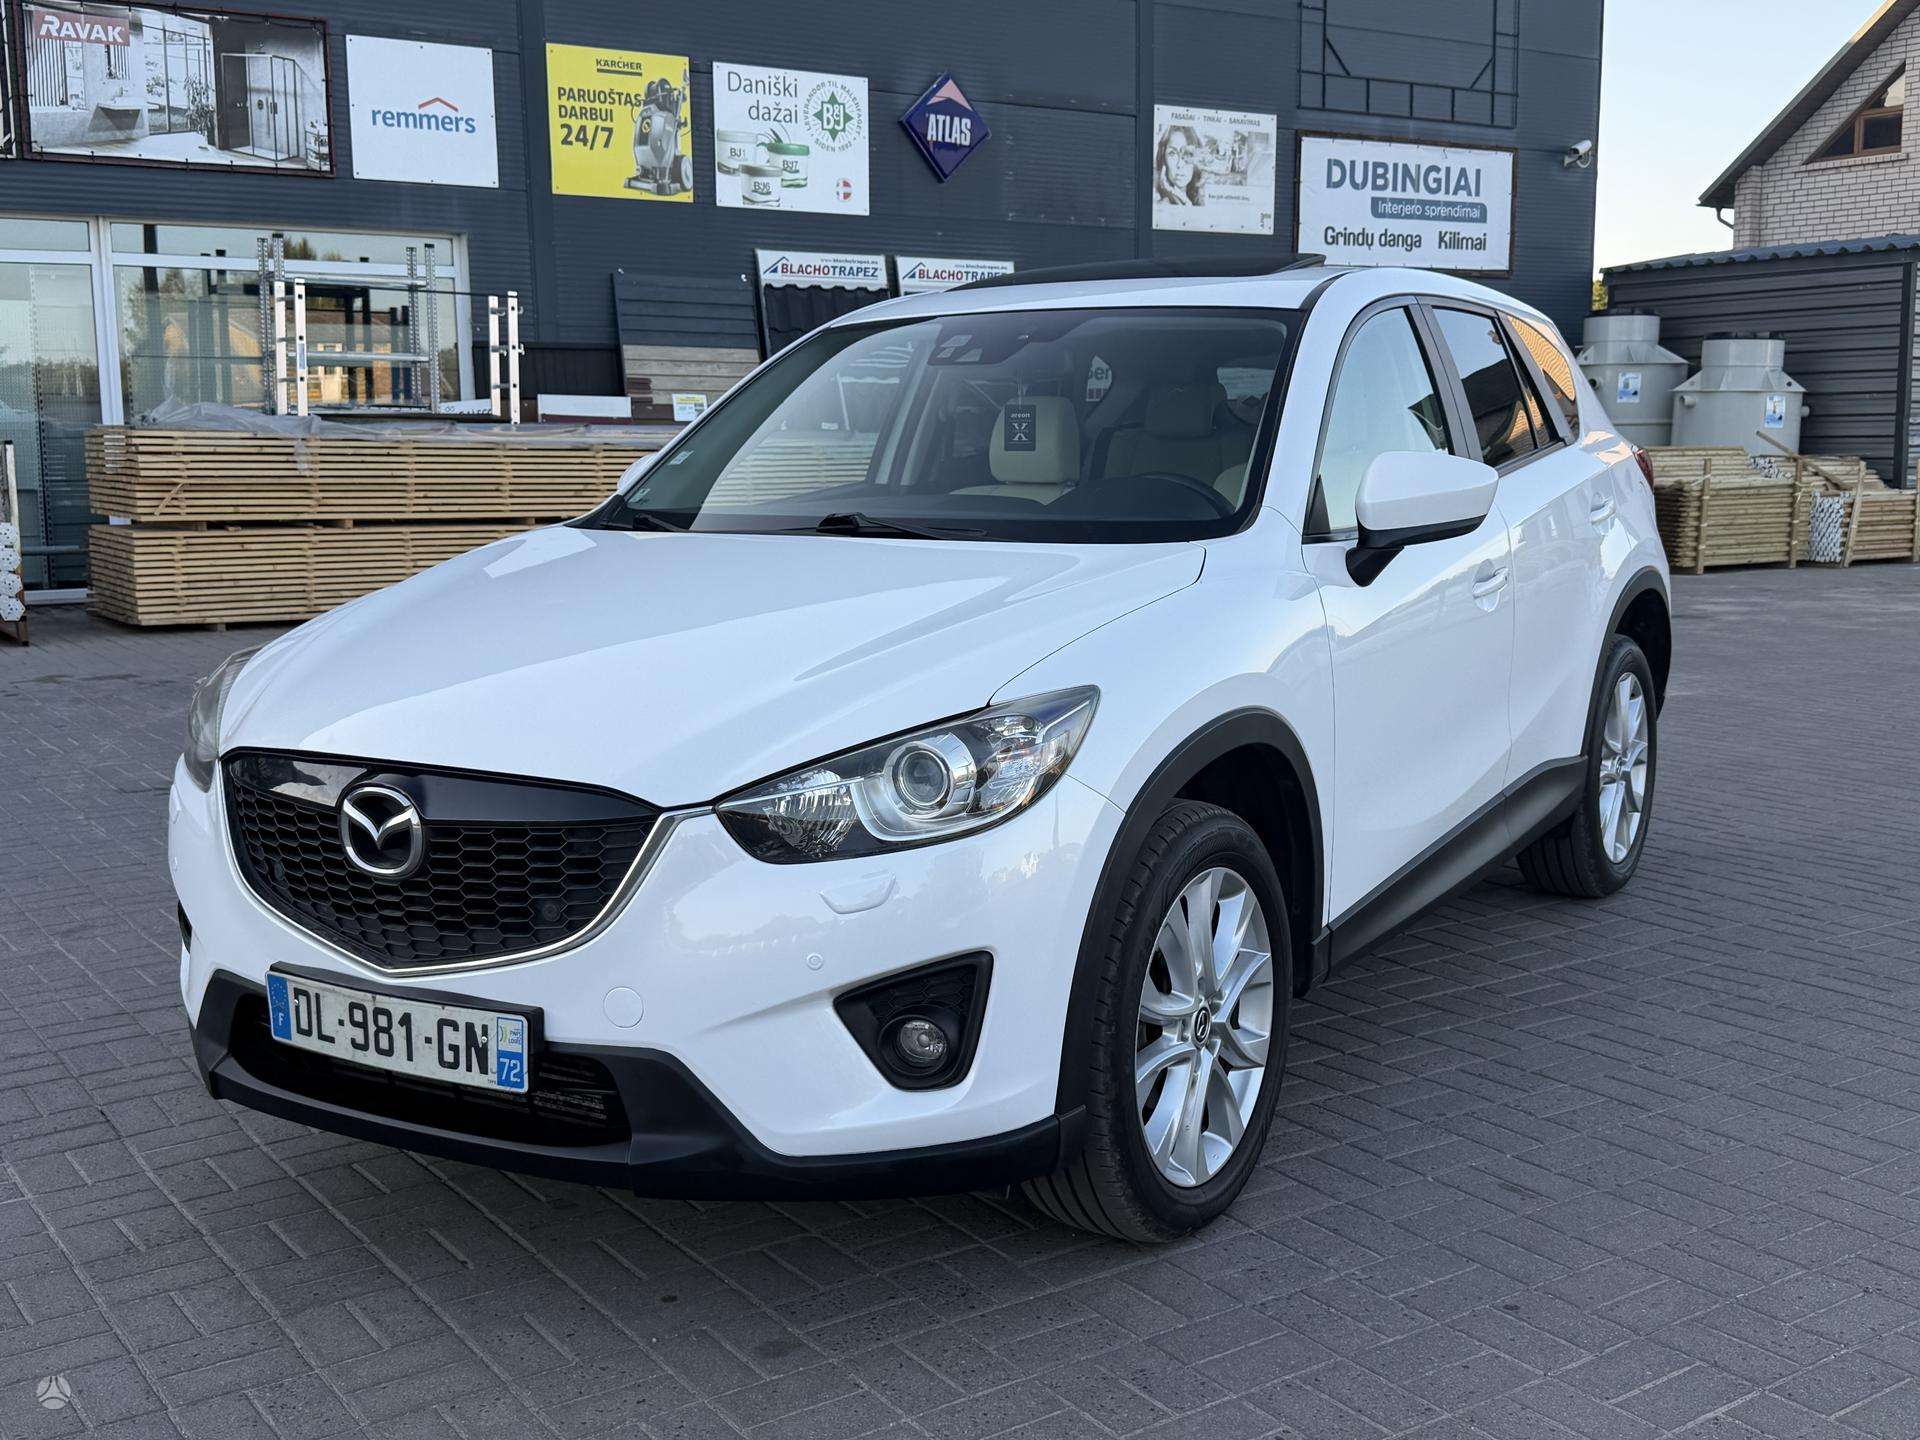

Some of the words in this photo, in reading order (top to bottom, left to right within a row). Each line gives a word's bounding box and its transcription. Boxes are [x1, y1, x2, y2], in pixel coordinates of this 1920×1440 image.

[39, 14, 125, 45] RAVAK
[557, 86, 642, 107] PARUOŠTAS
[726, 71, 799, 97] Daniški
[371, 106, 476, 134] remmers
[558, 104, 614, 122] DARBUI
[748, 100, 799, 124] dažai
[560, 123, 614, 151] 24/7
[926, 113, 972, 147] ATLAS
[1325, 158, 1482, 198] DUBINGIAI
[1378, 200, 1423, 217] Interjero
[1424, 204, 1481, 220] sprendimai
[1323, 225, 1375, 251] Grindų
[1378, 228, 1423, 253] danga
[1437, 230, 1488, 251] Kilimai
[780, 262, 879, 278] BLACHOTRAPEZ
[293, 986, 489, 1075] DL-981-GN
[499, 1057, 521, 1083] 72
